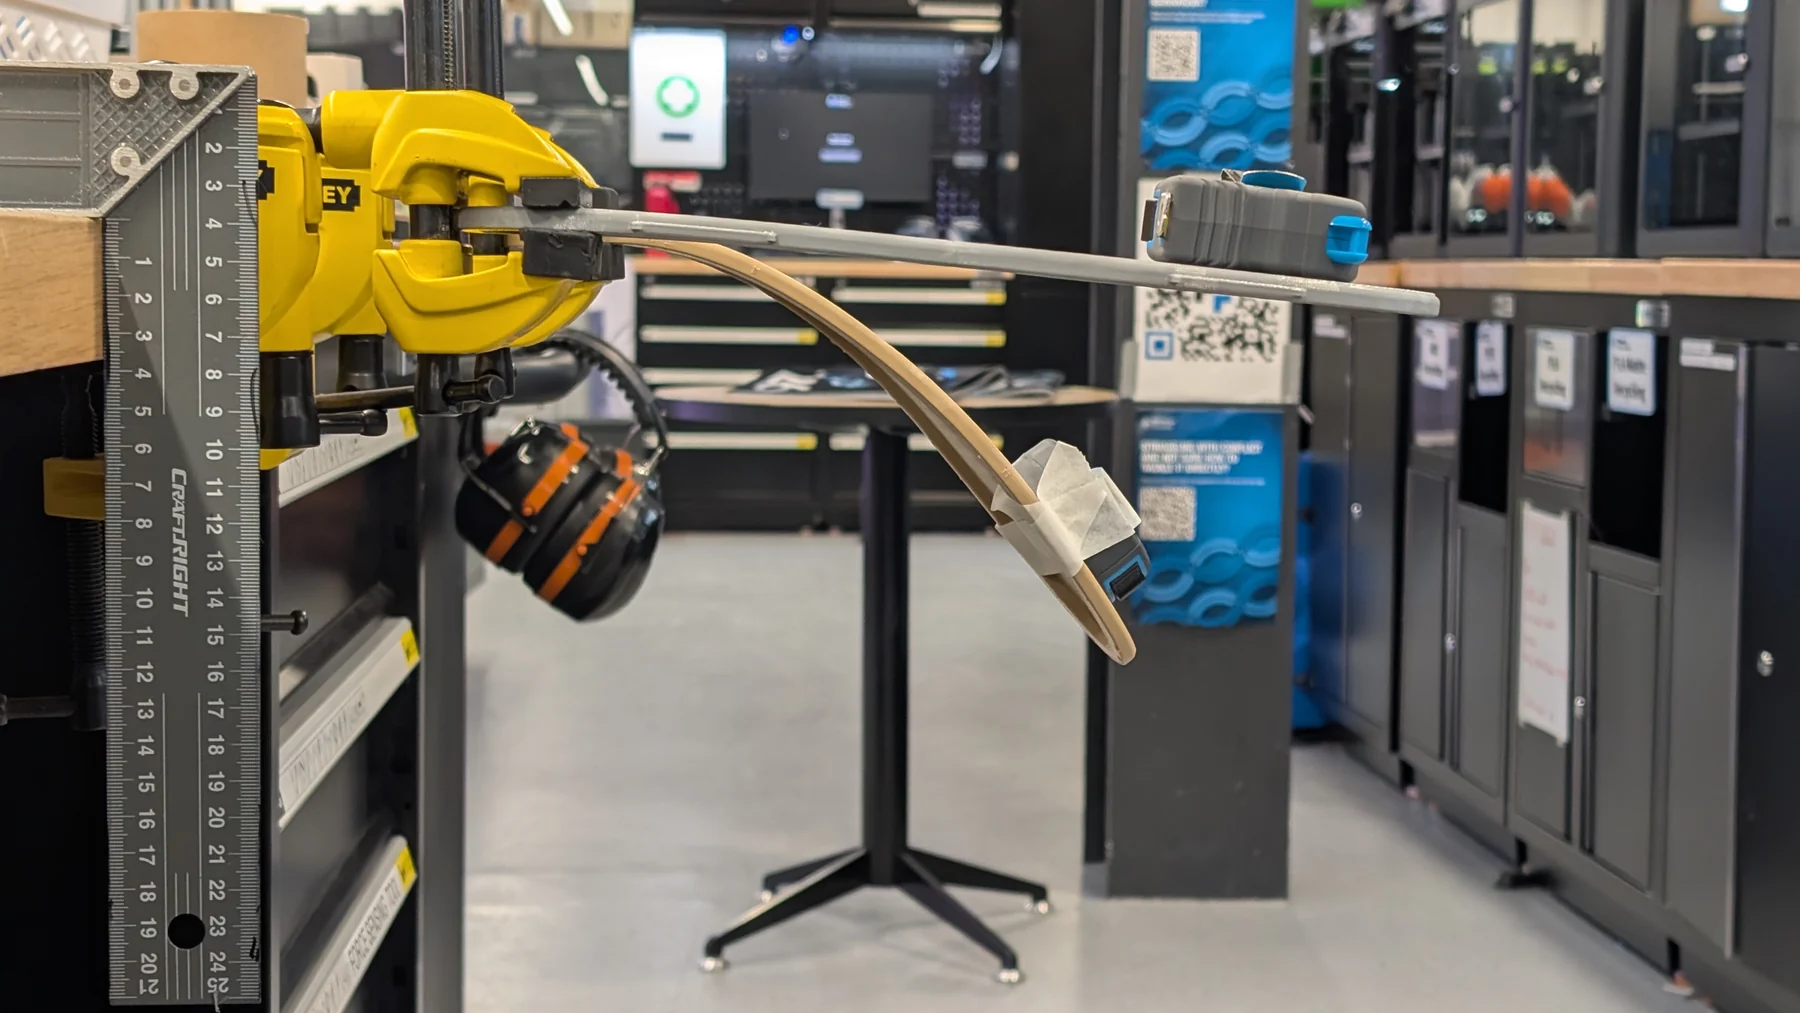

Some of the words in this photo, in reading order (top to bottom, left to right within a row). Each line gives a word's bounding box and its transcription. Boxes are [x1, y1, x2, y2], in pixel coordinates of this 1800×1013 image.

[205, 142, 223, 153] 2
[205, 180, 223, 191] 3
[205, 218, 223, 229] 4
[135, 257, 152, 265] 1
[206, 256, 224, 267] 5
[135, 293, 152, 304] 2
[206, 294, 224, 305] 6
[135, 330, 152, 341] 3
[206, 331, 224, 343] 7
[136, 368, 153, 379] 4
[206, 369, 224, 380] 8
[136, 406, 153, 417] 5
[207, 406, 224, 417] 9
[136, 443, 153, 454] 6
[207, 439, 224, 460] 10
[136, 480, 154, 492] 7
[207, 478, 225, 496] 11
[137, 518, 154, 529] 8
[207, 514, 225, 535] 12
[171, 467, 189, 617] CRAFTRIGHT
[137, 555, 154, 566] 9
[207, 551, 225, 571] 13
[137, 588, 154, 609] 10
[208, 588, 225, 608] 14
[137, 626, 154, 645] 11
[208, 624, 225, 645] 15
[137, 662, 155, 683] 12
[208, 661, 225, 682] 16
[138, 698, 155, 719] 13
[208, 698, 226, 719] 17
[138, 735, 155, 756] 14
[208, 735, 226, 755] 18
[138, 772, 156, 793] 15
[209, 771, 226, 792] 19
[138, 809, 156, 829] 16
[209, 807, 226, 828] 20
[139, 845, 156, 866] 17
[209, 845, 226, 863] 21
[139, 881, 156, 902] 18
[209, 880, 226, 901] 22
[139, 917, 156, 938] 19
[210, 916, 227, 937] 23
[139, 953, 157, 974] 20
[210, 952, 227, 973] 24
